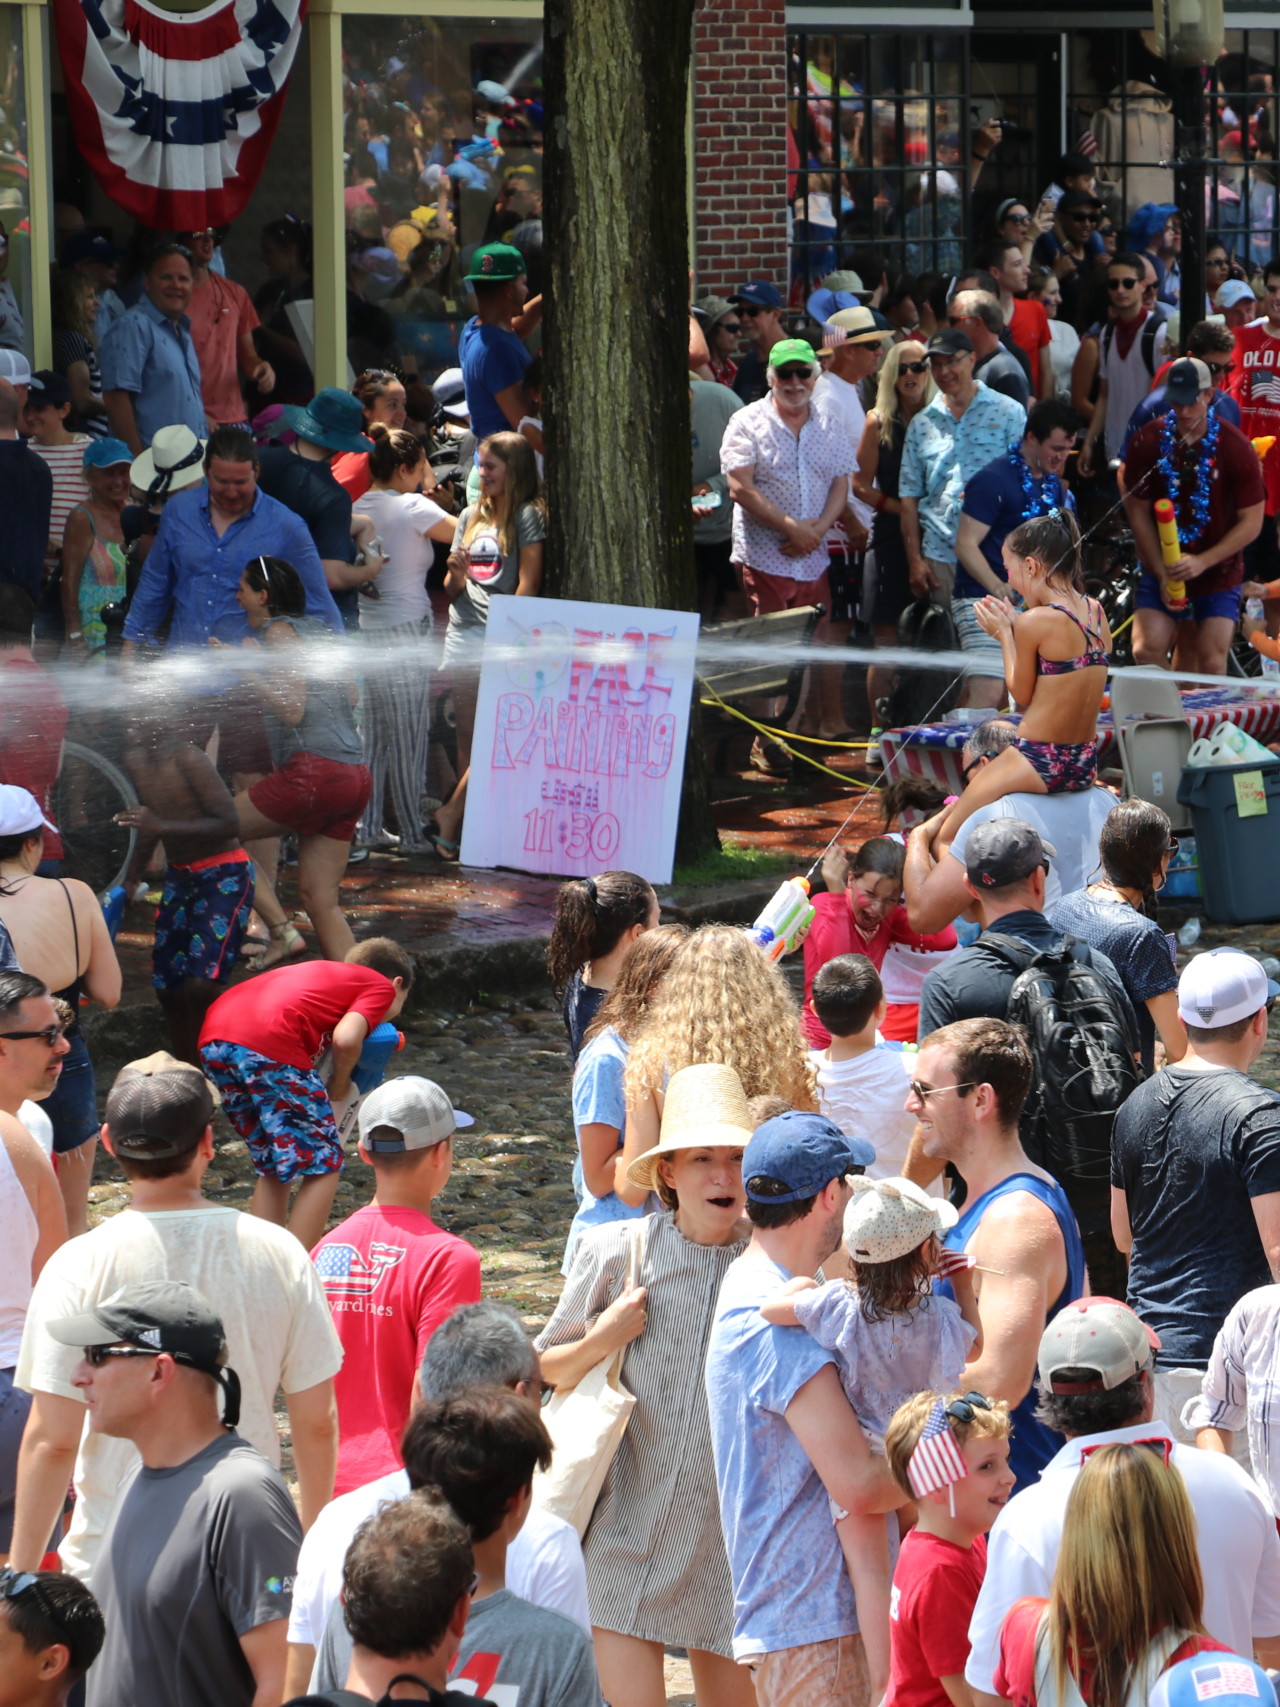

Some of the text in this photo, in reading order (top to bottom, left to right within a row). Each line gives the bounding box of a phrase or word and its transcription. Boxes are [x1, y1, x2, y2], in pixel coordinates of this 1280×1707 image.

[1243, 350, 1275, 368] OLD
[523, 807, 620, 862] 11:30
[329, 1297, 364, 1313] yard
